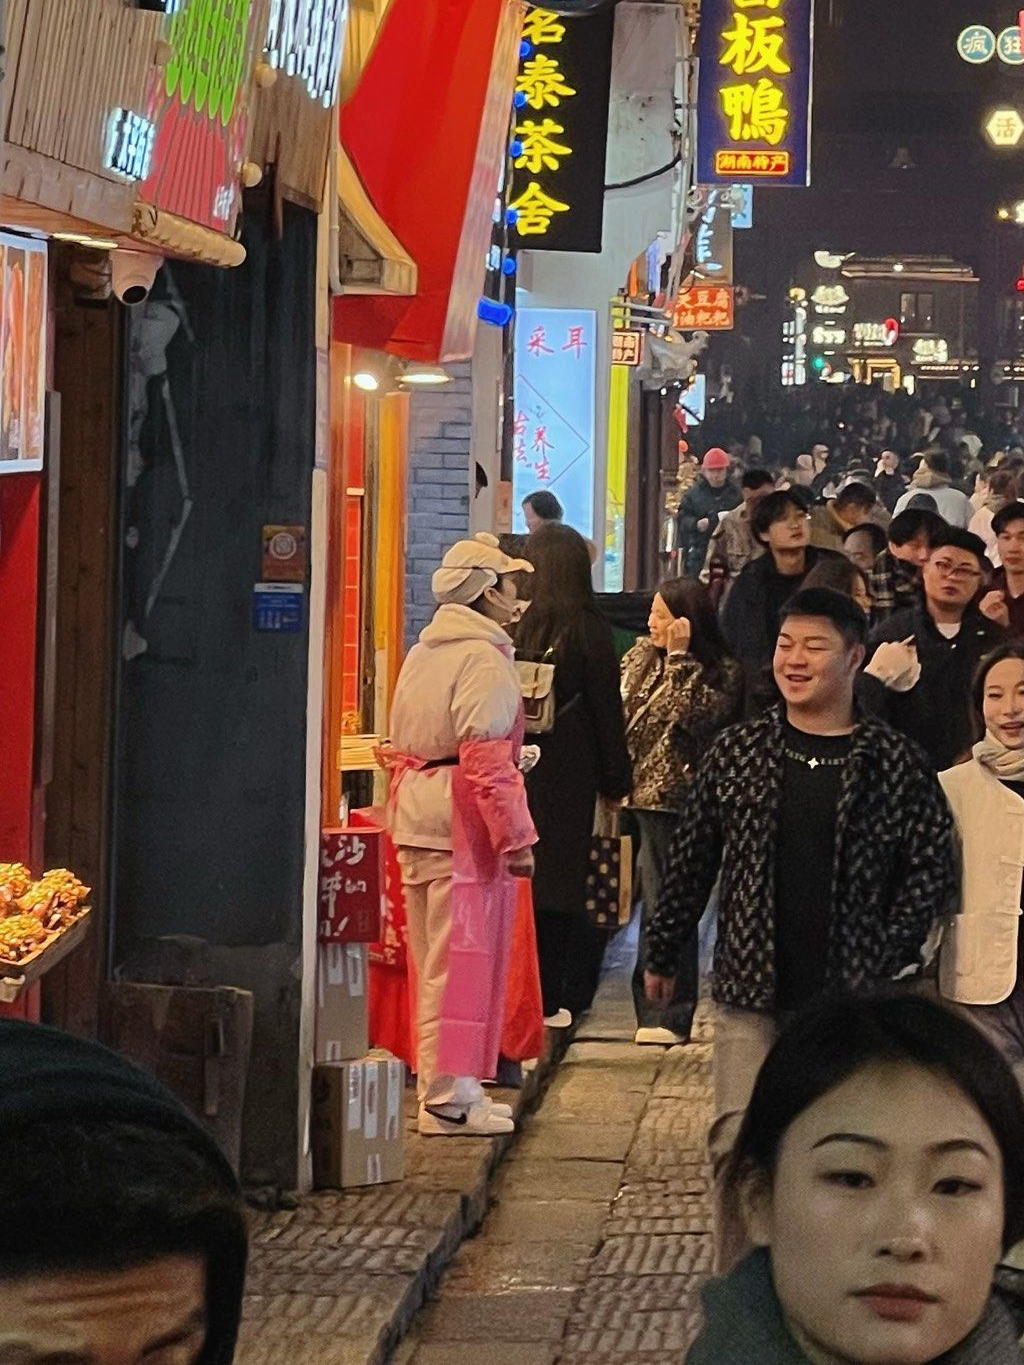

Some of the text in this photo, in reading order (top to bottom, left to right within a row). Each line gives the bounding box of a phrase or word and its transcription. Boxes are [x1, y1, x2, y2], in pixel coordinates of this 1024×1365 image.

[508, 6, 576, 236] 名泰茶舍
[527, 324, 588, 360] 采耳
